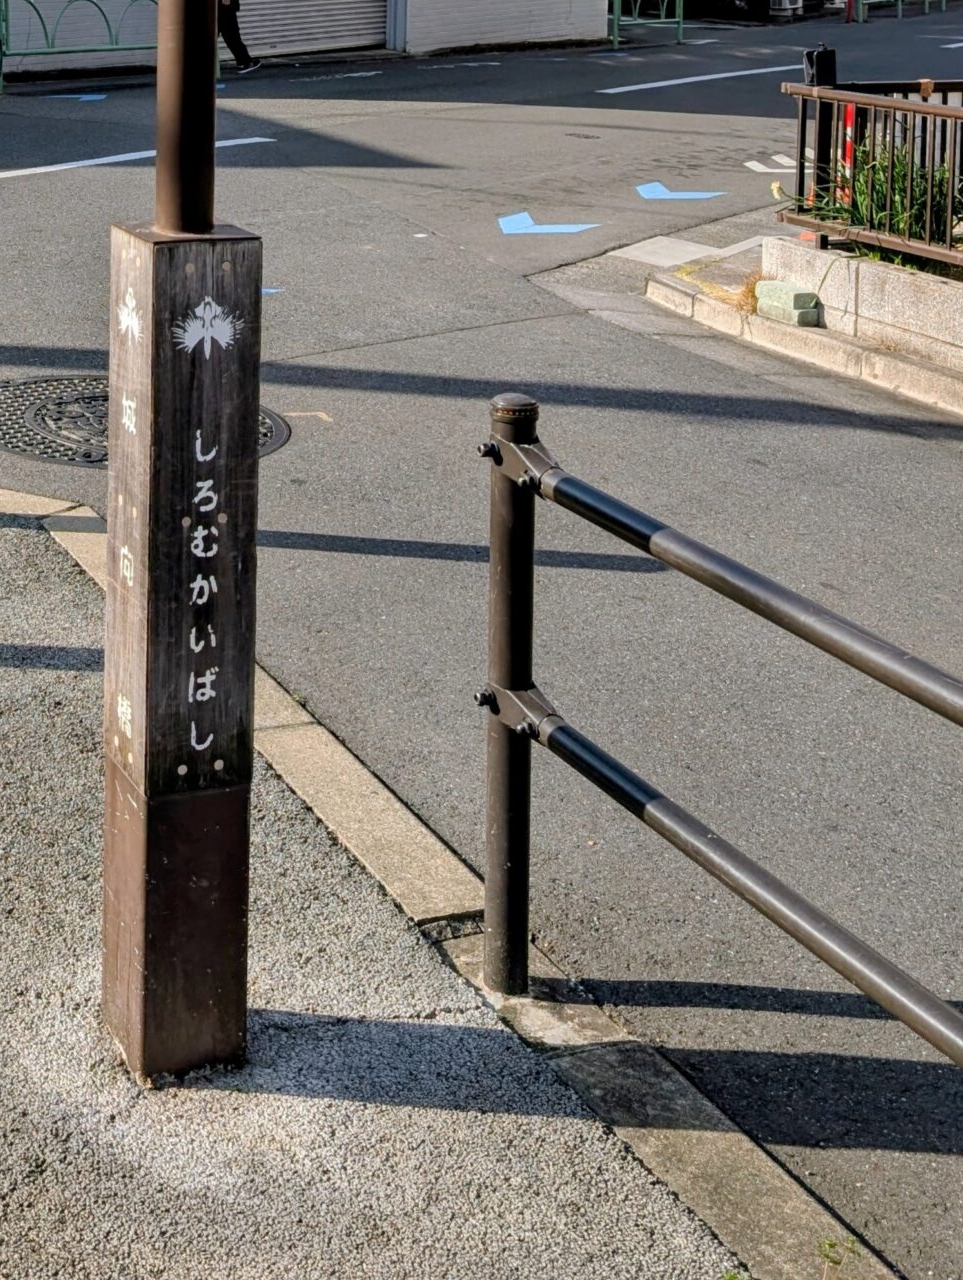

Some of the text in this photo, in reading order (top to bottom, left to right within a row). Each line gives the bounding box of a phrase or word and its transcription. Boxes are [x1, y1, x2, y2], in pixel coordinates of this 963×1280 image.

[188, 428, 219, 752] しろむかいばし
